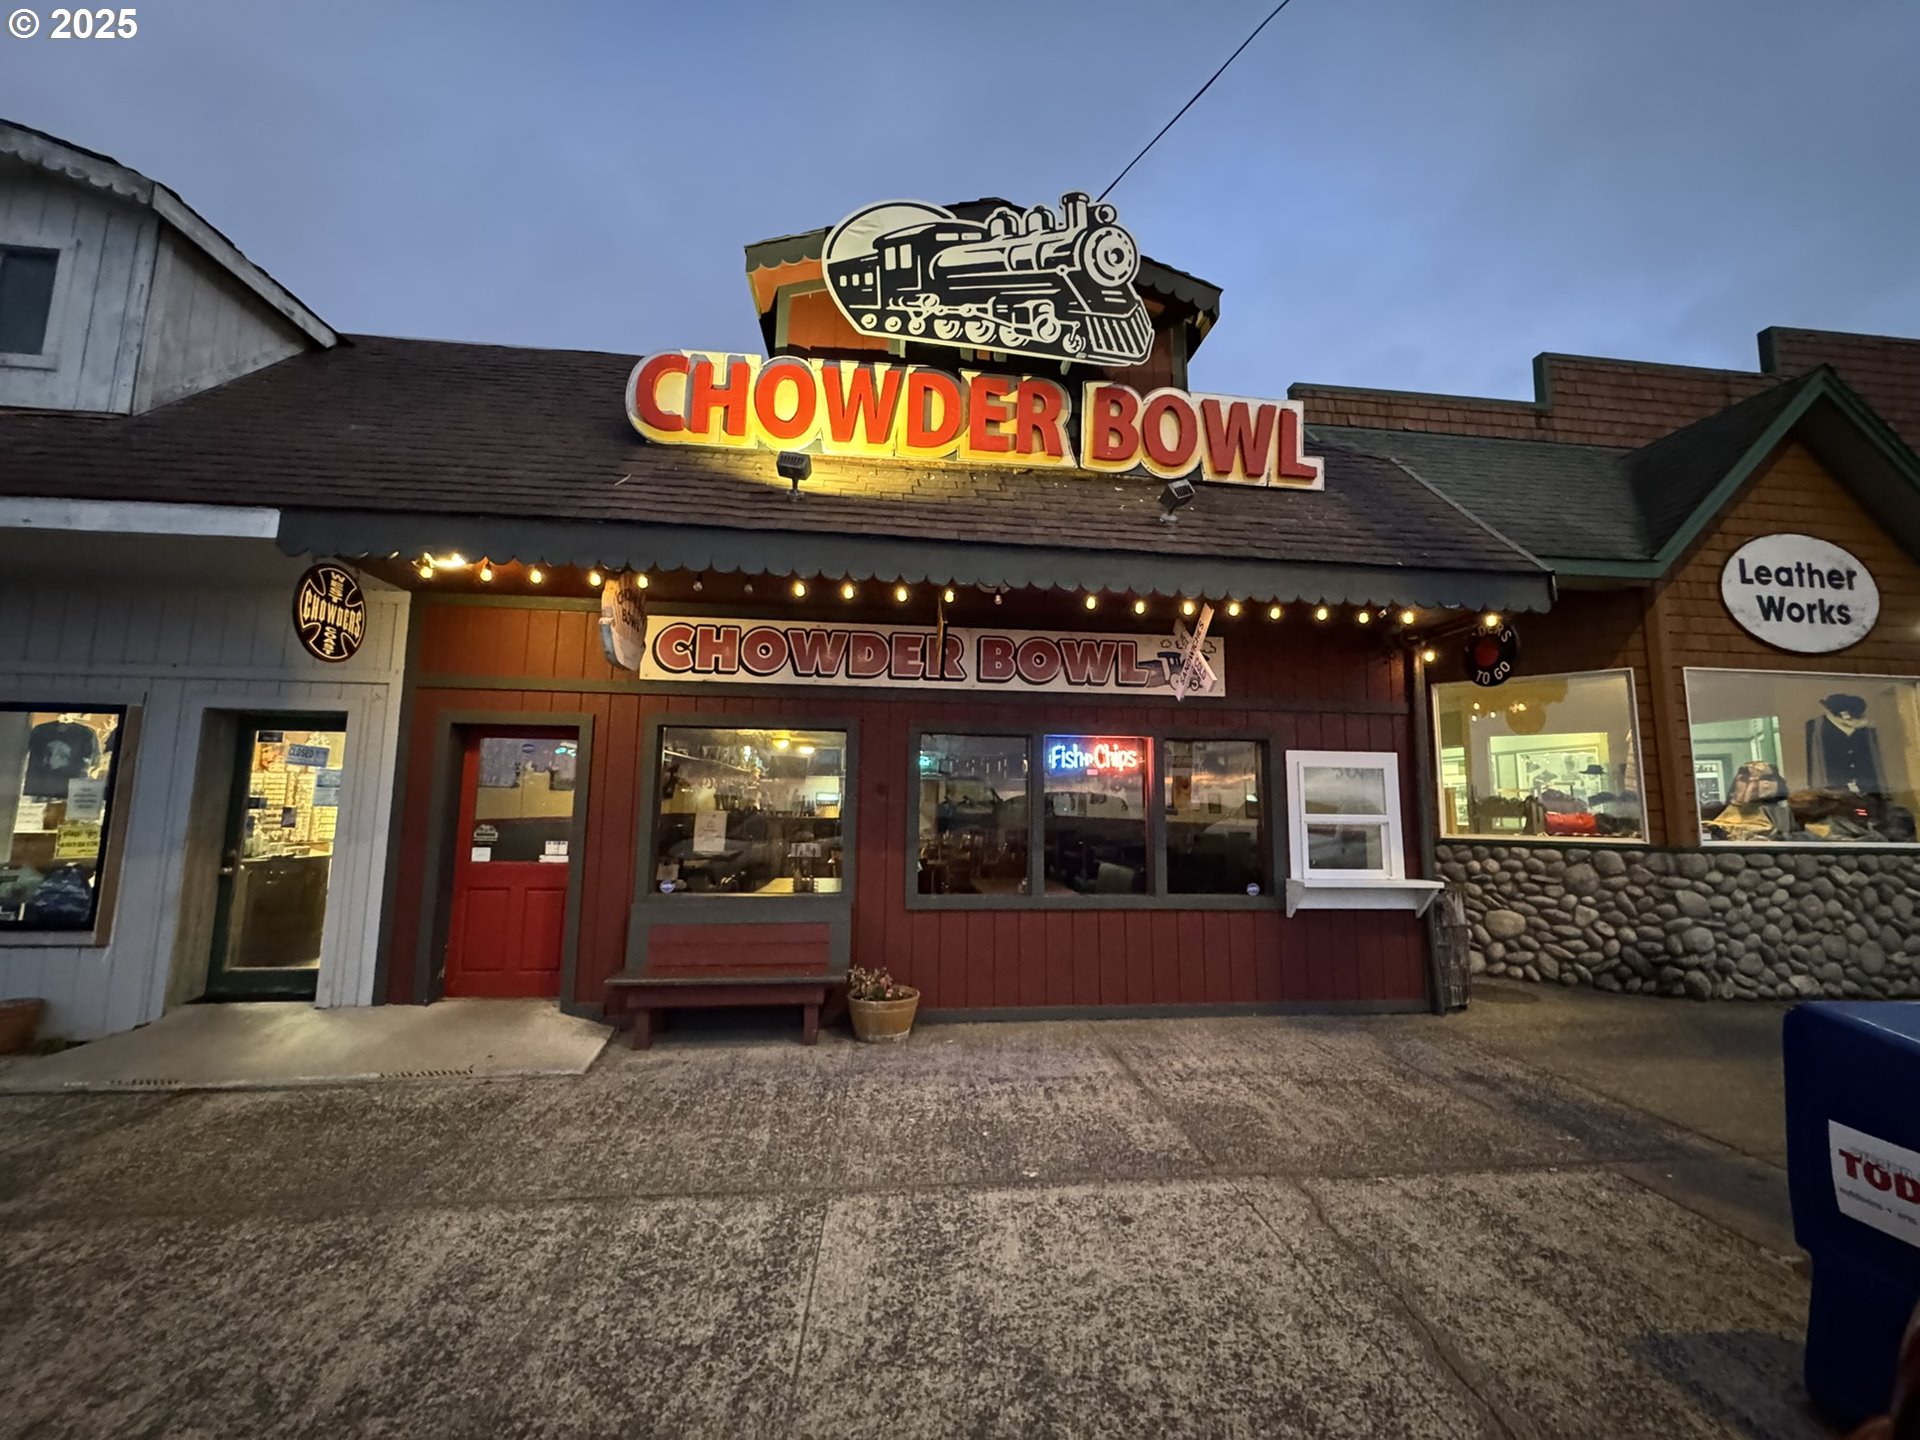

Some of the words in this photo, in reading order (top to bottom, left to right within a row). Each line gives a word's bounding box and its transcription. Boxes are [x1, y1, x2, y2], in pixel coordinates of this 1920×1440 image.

[636, 353, 1063, 457] CHOWDER
[1092, 386, 1318, 479] BOWL
[328, 571, 346, 603] WEST
[1738, 558, 1857, 590] Leather
[303, 588, 362, 640] CHOWDERS
[1756, 595, 1852, 625] Works
[322, 626, 337, 655] COAST
[653, 622, 967, 682] CHOWDER
[977, 635, 1150, 687] BOWL
[1476, 669, 1490, 685] TO
[1494, 661, 1511, 680] GO
[1051, 744, 1084, 769] Fish
[1094, 743, 1138, 771] Chips
[1838, 1148, 1920, 1205] TOD
